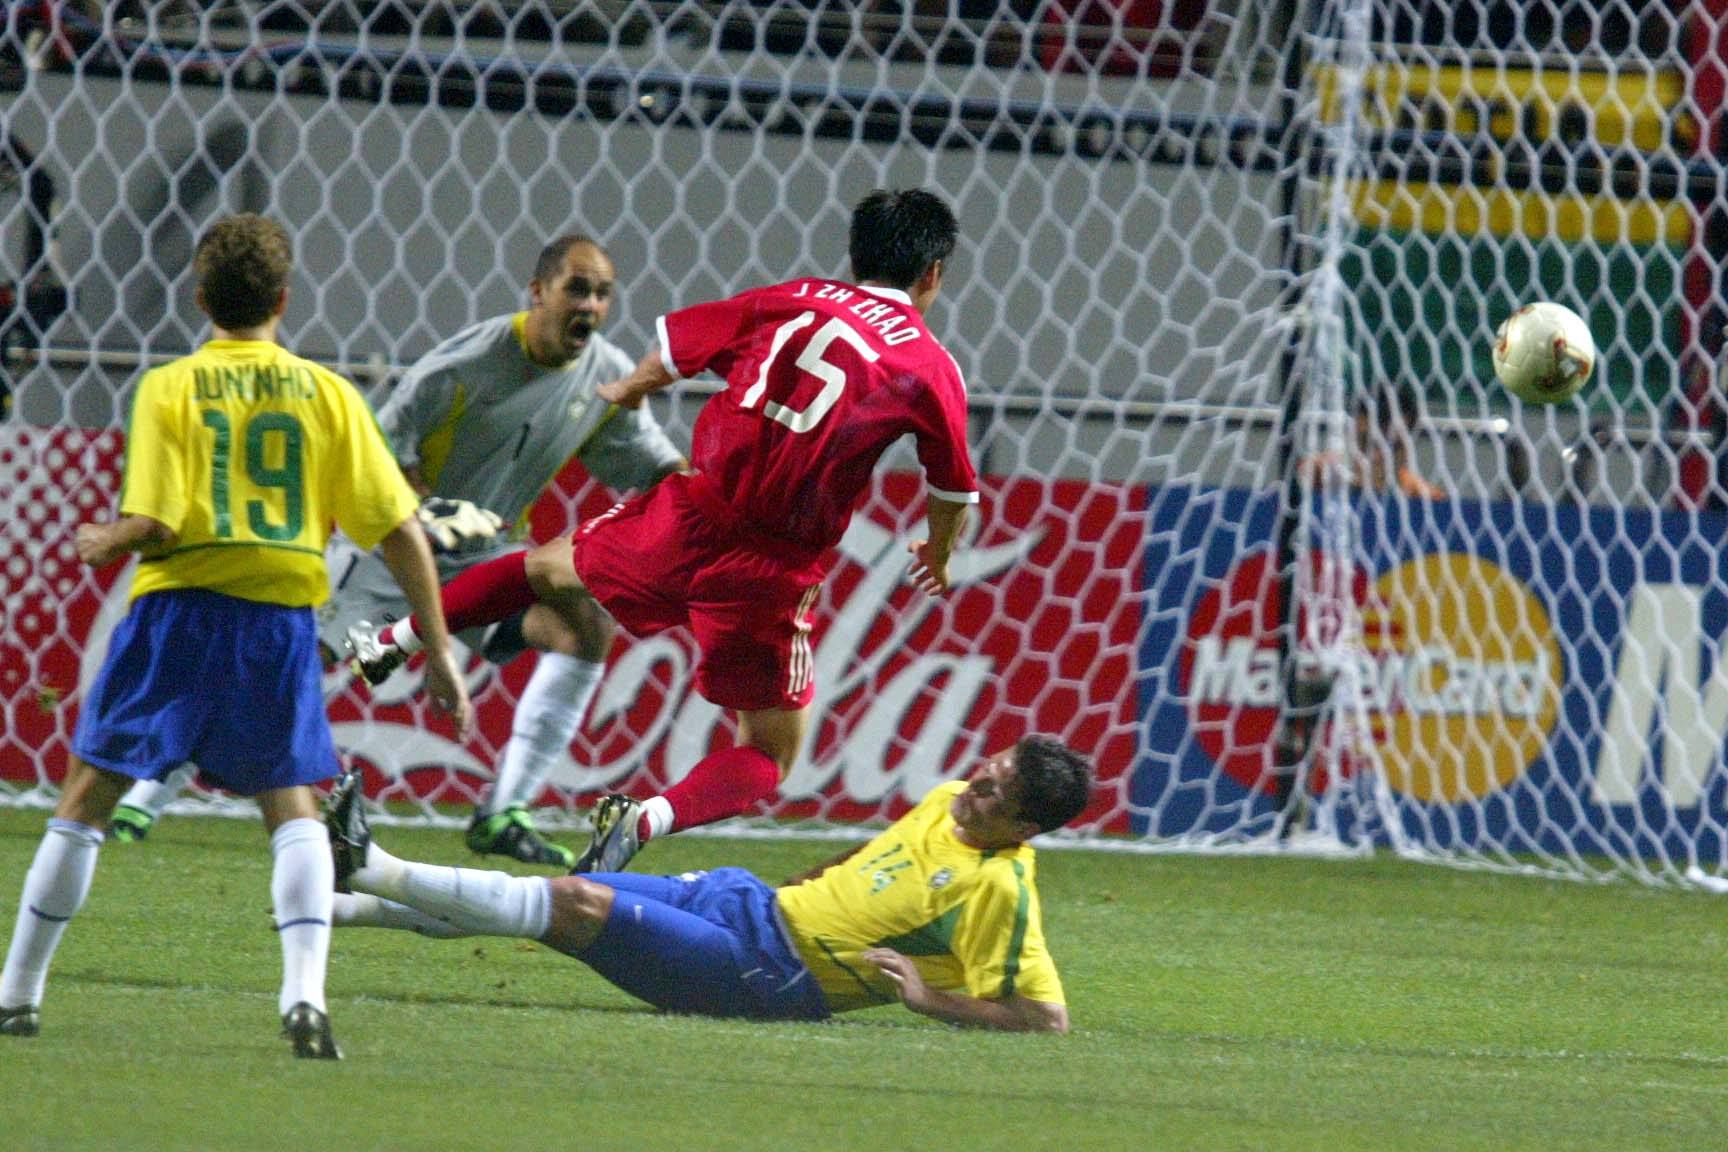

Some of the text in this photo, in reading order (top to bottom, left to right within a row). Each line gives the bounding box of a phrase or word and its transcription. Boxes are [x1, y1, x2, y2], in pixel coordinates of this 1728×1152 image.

[793, 283, 921, 346] J ZH ZHAO
[739, 310, 881, 434] 15
[202, 408, 305, 542] 19
[1188, 634, 1556, 717] MaerCard
